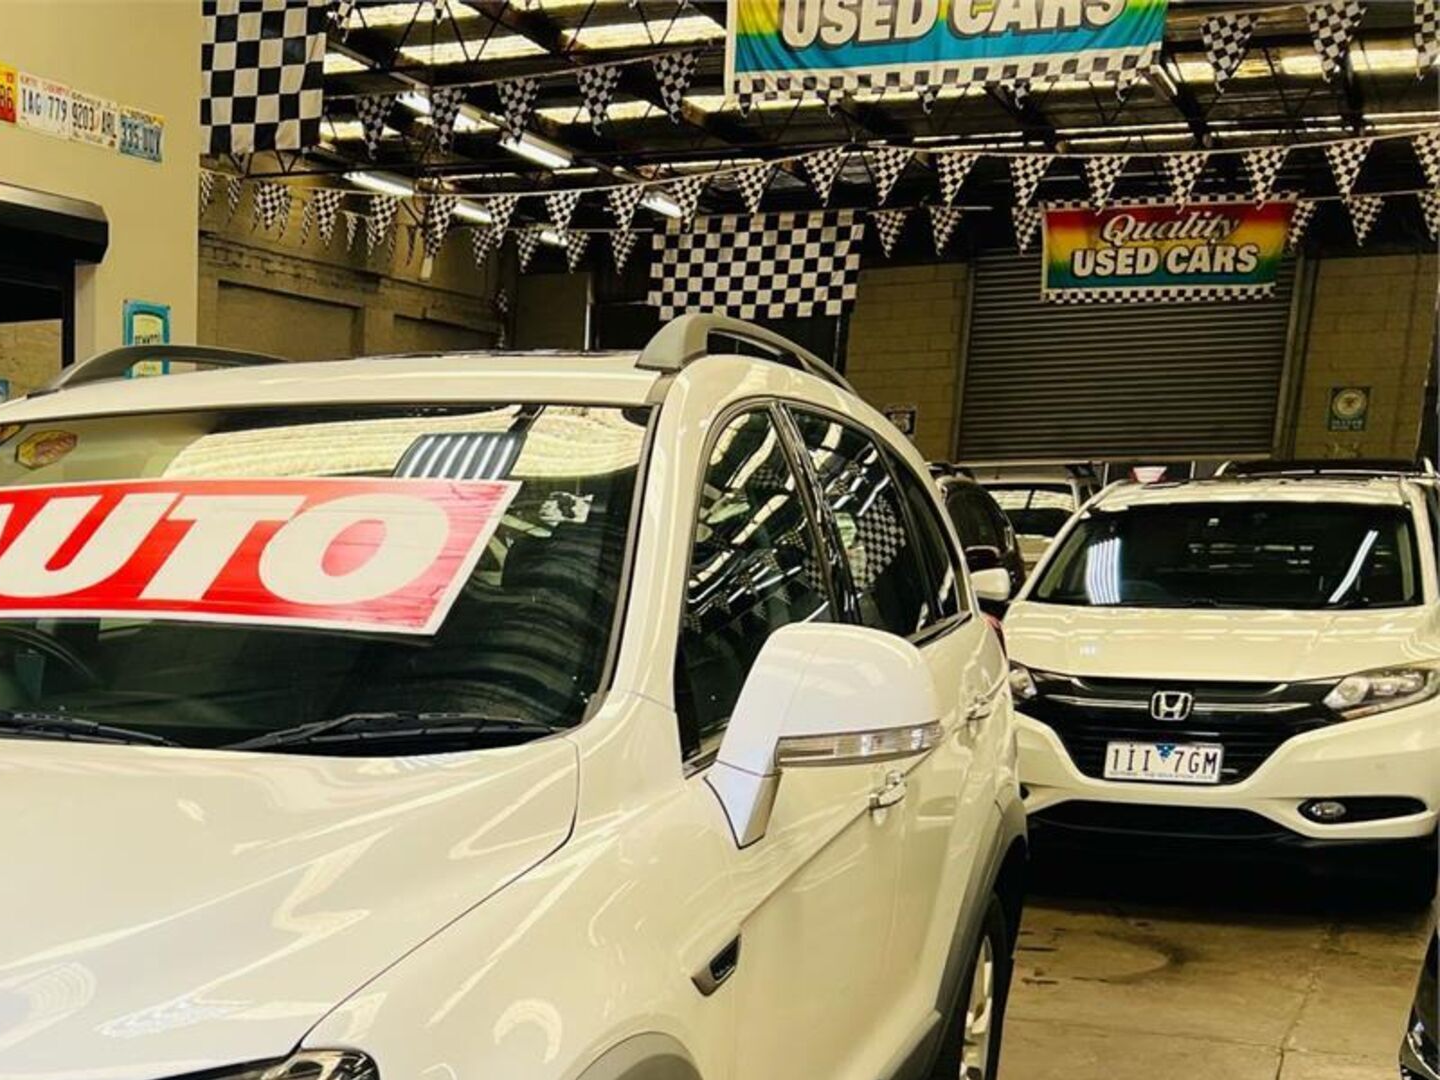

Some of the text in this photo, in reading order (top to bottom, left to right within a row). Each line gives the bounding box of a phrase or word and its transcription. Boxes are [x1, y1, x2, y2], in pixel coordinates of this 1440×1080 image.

[782, 0, 938, 49] USED
[1101, 208, 1241, 248] Quality
[1071, 244, 1259, 278] USED CARS
[1173, 750, 1218, 776] 7GM
